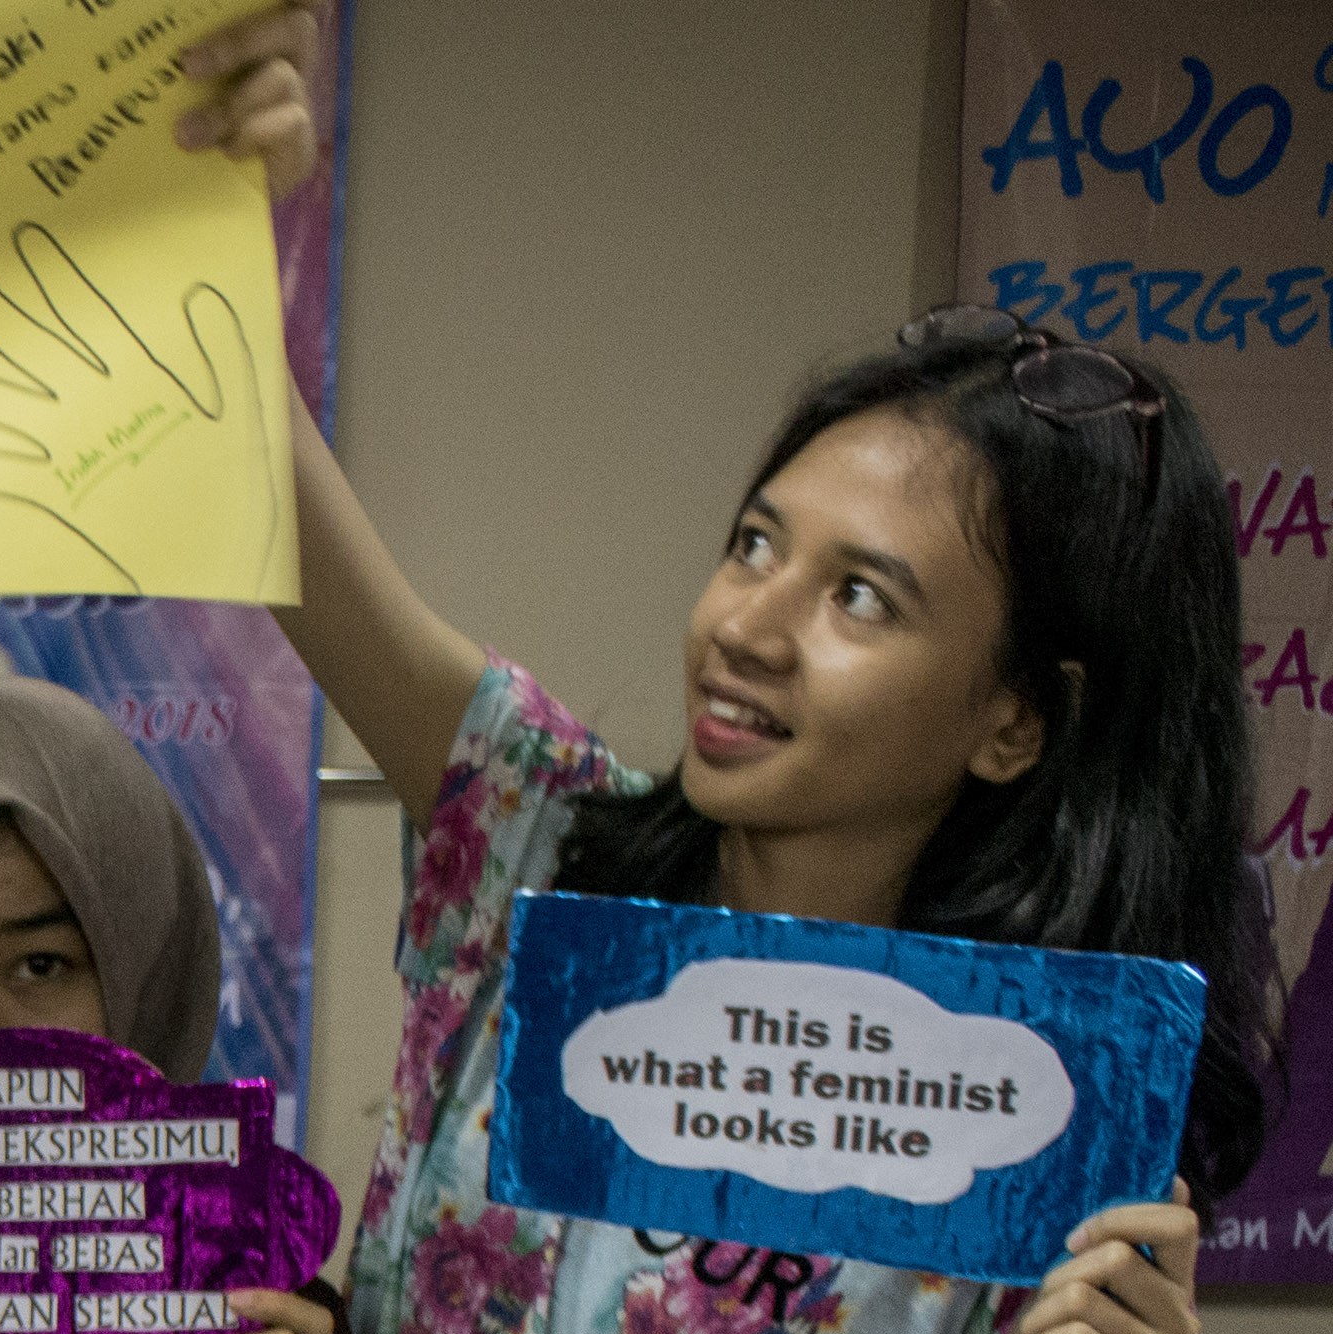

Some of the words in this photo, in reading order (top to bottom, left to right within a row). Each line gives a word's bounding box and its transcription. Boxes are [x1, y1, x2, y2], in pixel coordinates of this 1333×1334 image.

[982, 56, 1292, 204] AYO
[988, 260, 1333, 350] BERGE
[724, 1005, 829, 1048] This
[848, 1013, 893, 1054] is
[602, 1050, 728, 1091] what
[743, 1065, 771, 1095] a
[790, 1060, 1020, 1115] feminist
[673, 1101, 817, 1149] looks
[832, 1114, 933, 1158] like
[52, 1237, 164, 1271] BEBAS
